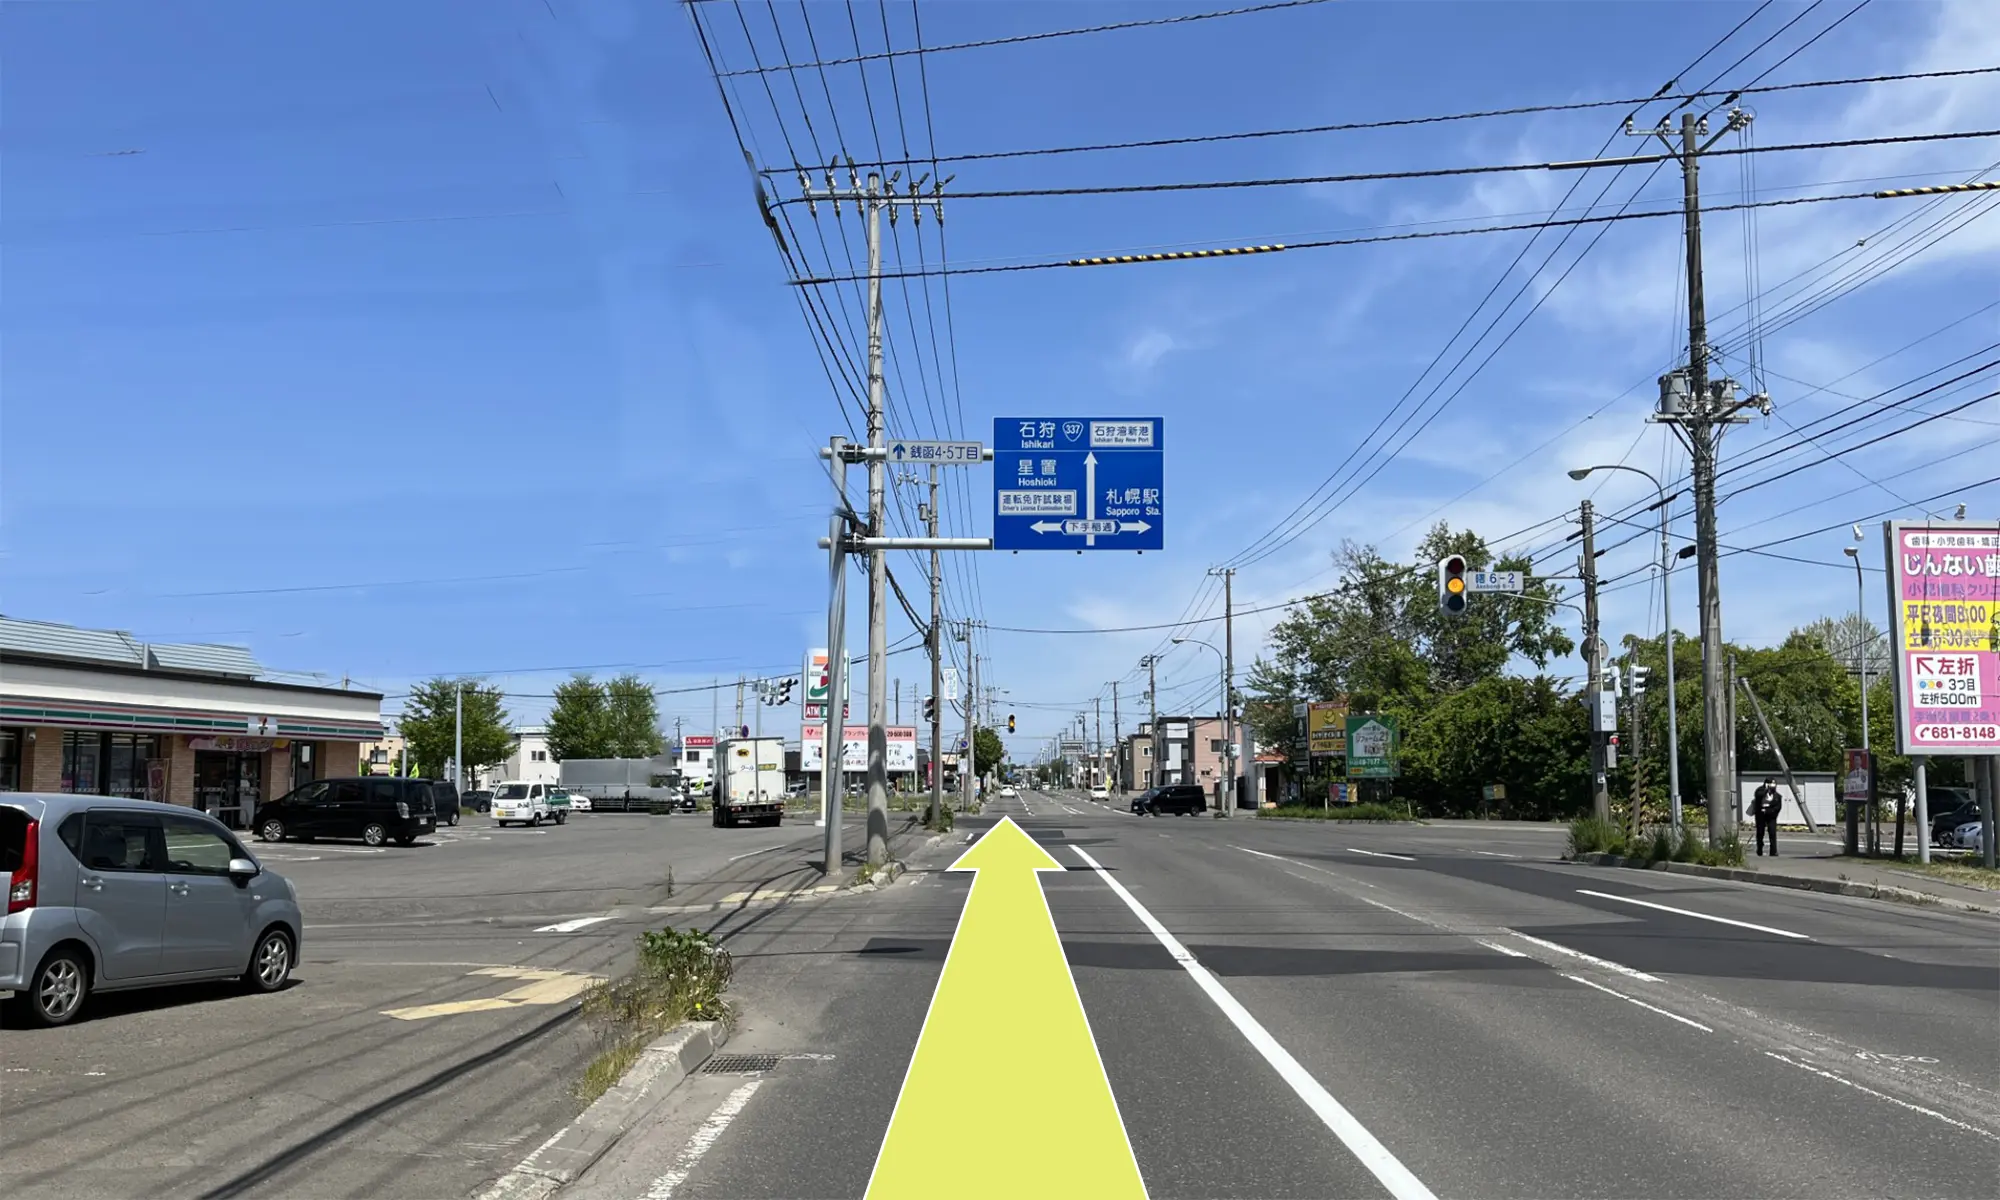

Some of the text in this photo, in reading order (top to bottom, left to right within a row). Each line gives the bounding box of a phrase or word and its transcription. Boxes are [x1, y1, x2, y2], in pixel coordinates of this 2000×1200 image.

[1019, 421, 1056, 438] 石狩
[1065, 424, 1080, 434] 337
[1094, 425, 1149, 436] 石狩湾新港
[1021, 440, 1054, 448] Ishikari
[1018, 459, 1057, 475] 星置
[1018, 477, 1057, 487] Hoshioki
[1003, 494, 1073, 504] 運転免許試験場
[1105, 488, 1160, 505] 札幌駅
[1105, 506, 1161, 517] Sapporo Sta.
[1068, 522, 1113, 532] 下手稲通
[1937, 656, 1975, 676] 左折
[1948, 678, 1975, 691] 3つ目
[1919, 692, 1977, 705] 左折500m
[1931, 726, 1996, 739] 681-8148
